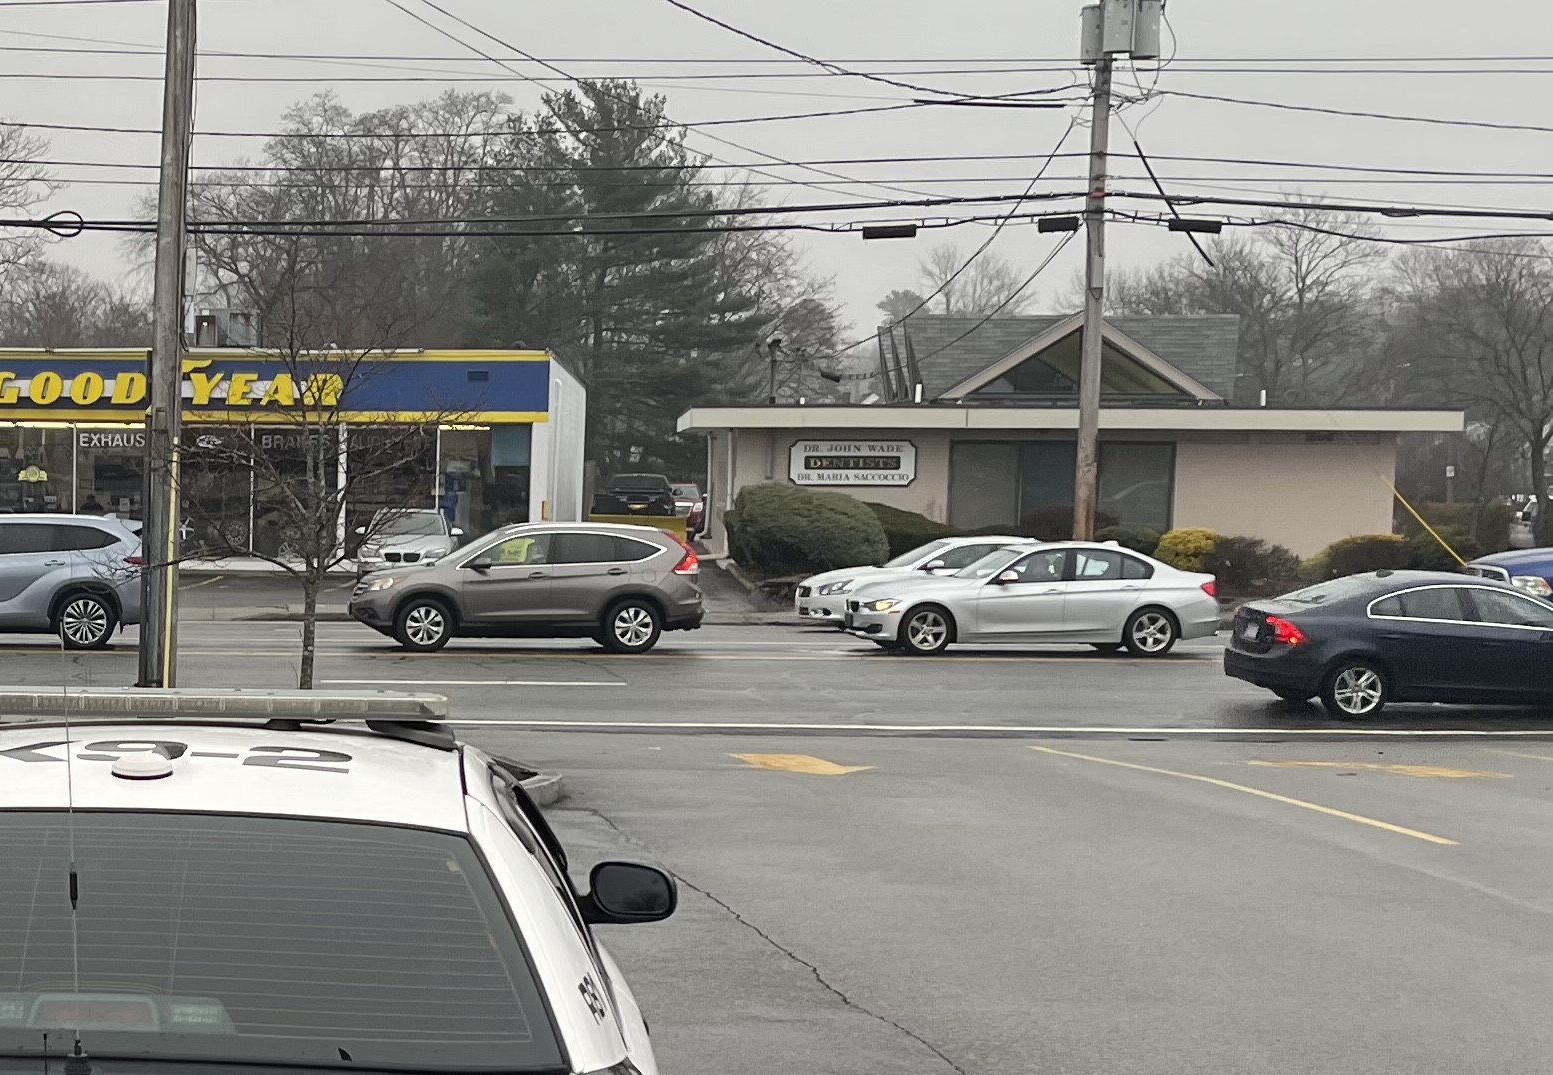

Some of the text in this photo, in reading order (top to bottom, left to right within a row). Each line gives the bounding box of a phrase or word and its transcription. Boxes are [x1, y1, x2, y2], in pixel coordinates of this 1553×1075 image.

[79, 433, 146, 447] EXHAUS
[827, 444, 861, 453] JOHN
[867, 444, 904, 453] WADE
[810, 458, 898, 468] DENTISTS
[816, 473, 850, 481] MARIA
